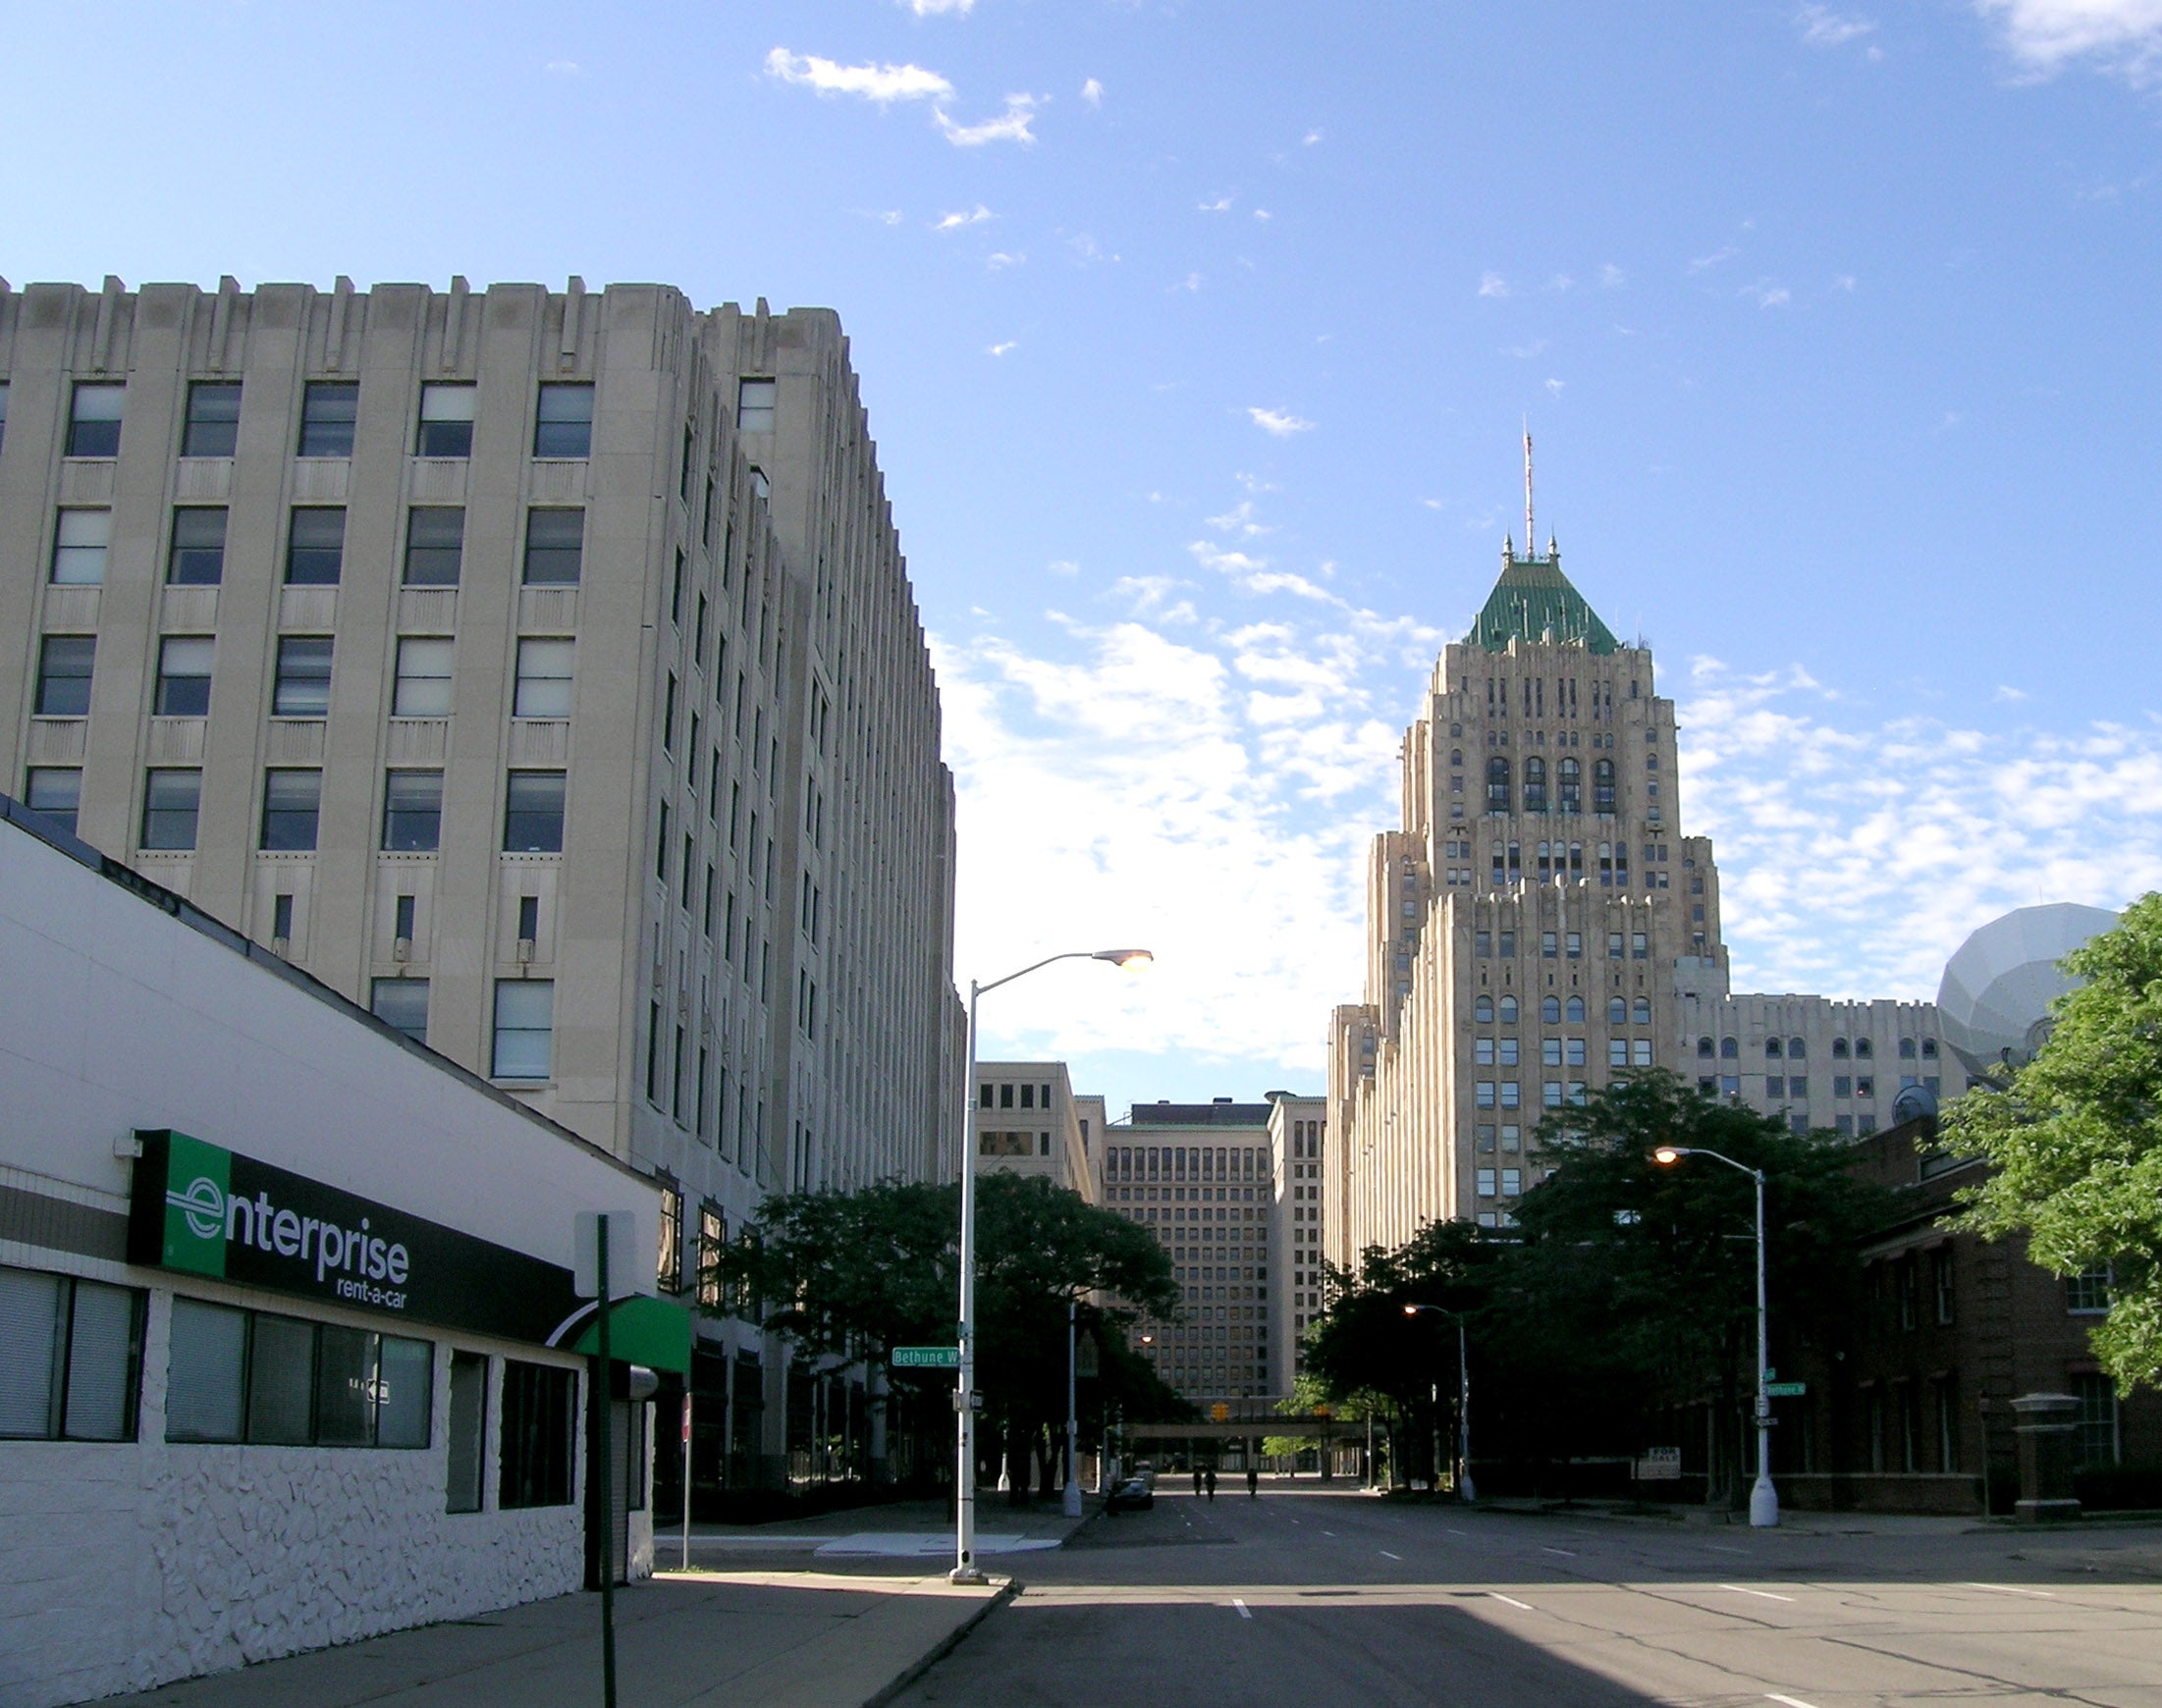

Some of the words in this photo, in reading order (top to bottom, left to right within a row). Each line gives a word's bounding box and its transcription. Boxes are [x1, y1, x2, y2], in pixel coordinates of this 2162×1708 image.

[166, 1177, 409, 1284] enterprise
[337, 1277, 407, 1309] rent-a-car
[894, 1351, 944, 1363] Bethune
[947, 1351, 958, 1363] W
